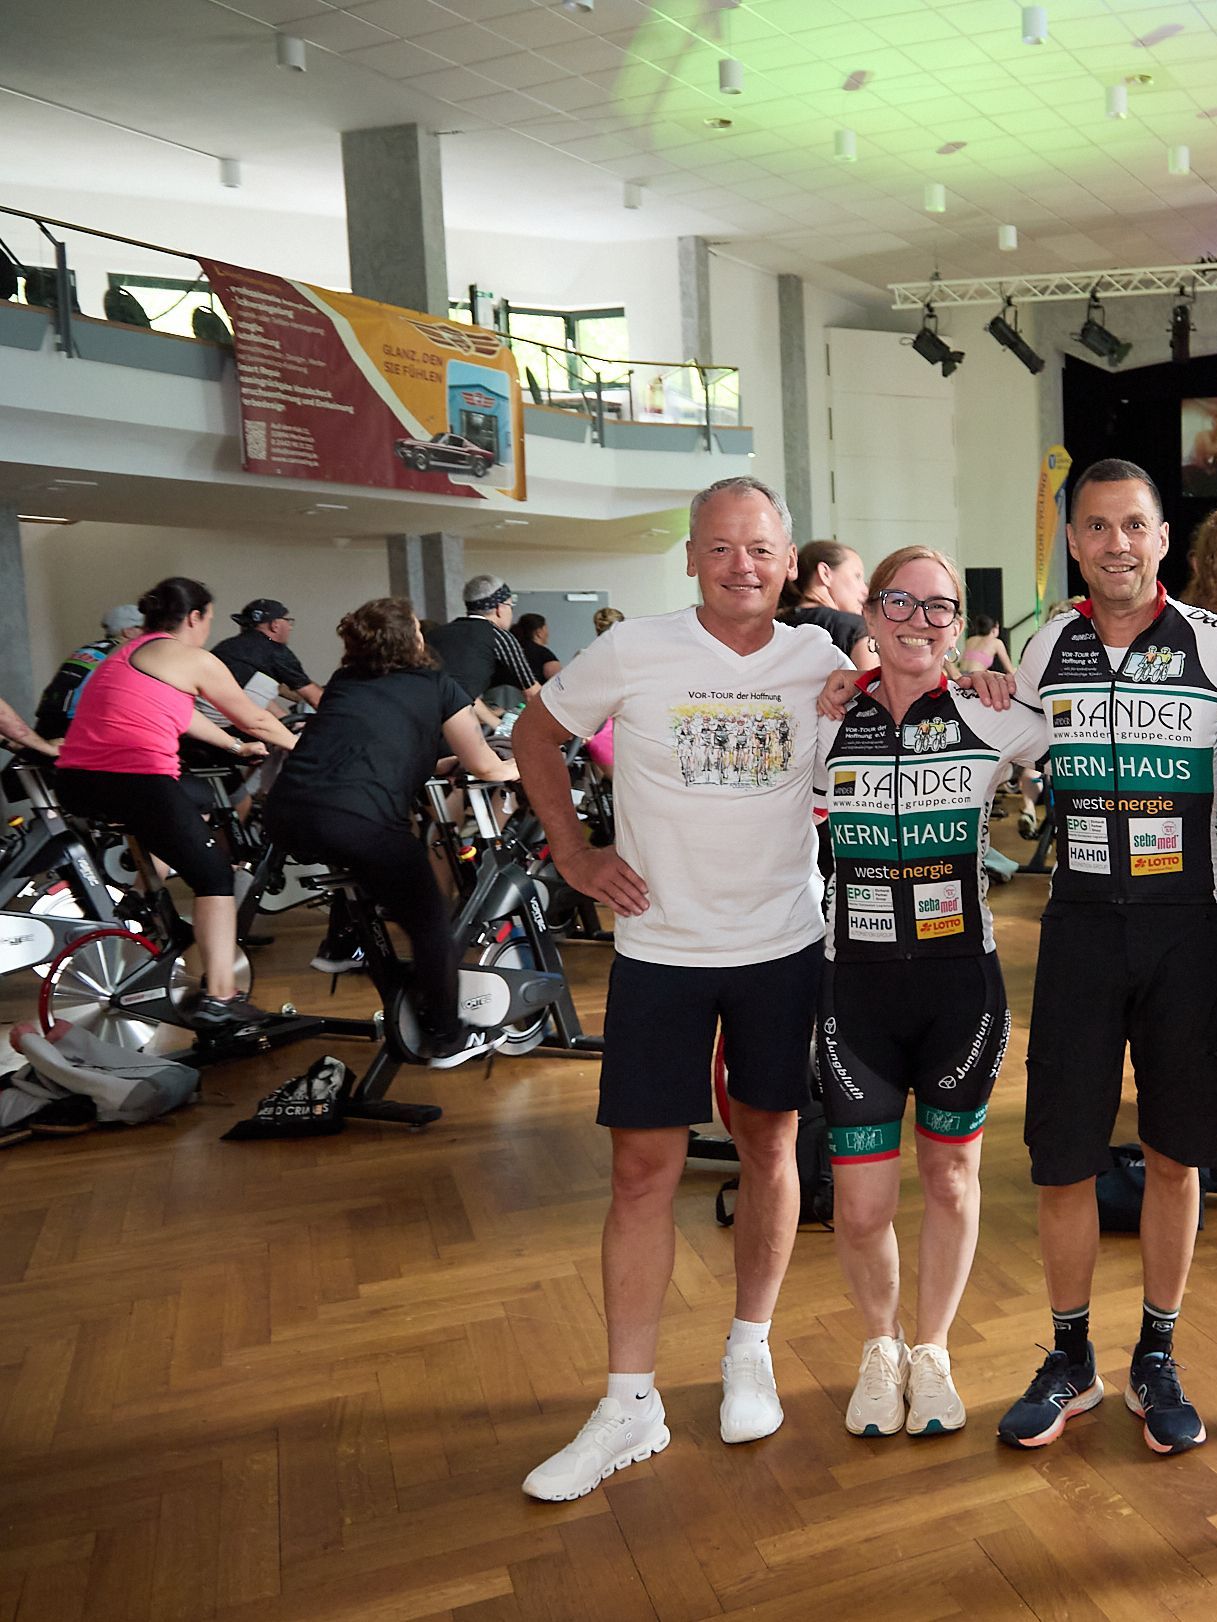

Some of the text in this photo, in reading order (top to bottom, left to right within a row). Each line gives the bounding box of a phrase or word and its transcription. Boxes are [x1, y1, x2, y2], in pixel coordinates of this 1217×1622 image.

[422, 352, 443, 366] DEN
[384, 361, 442, 383] SIE FÜHLEN
[688, 691, 781, 702] VOR-TOUR der Hoffnung
[1077, 699, 1192, 731] SANDER
[862, 766, 972, 799] SANDER
[1067, 819, 1088, 831] EPG
[1070, 847, 1107, 862] HAHN
[1148, 856, 1179, 867] LOTTO
[848, 888, 871, 900] EPG
[850, 916, 892, 930] HAHN
[934, 919, 960, 930] LOTTO
[956, 1011, 991, 1080] Jungbluth
[825, 1037, 864, 1100] Jungbluth
